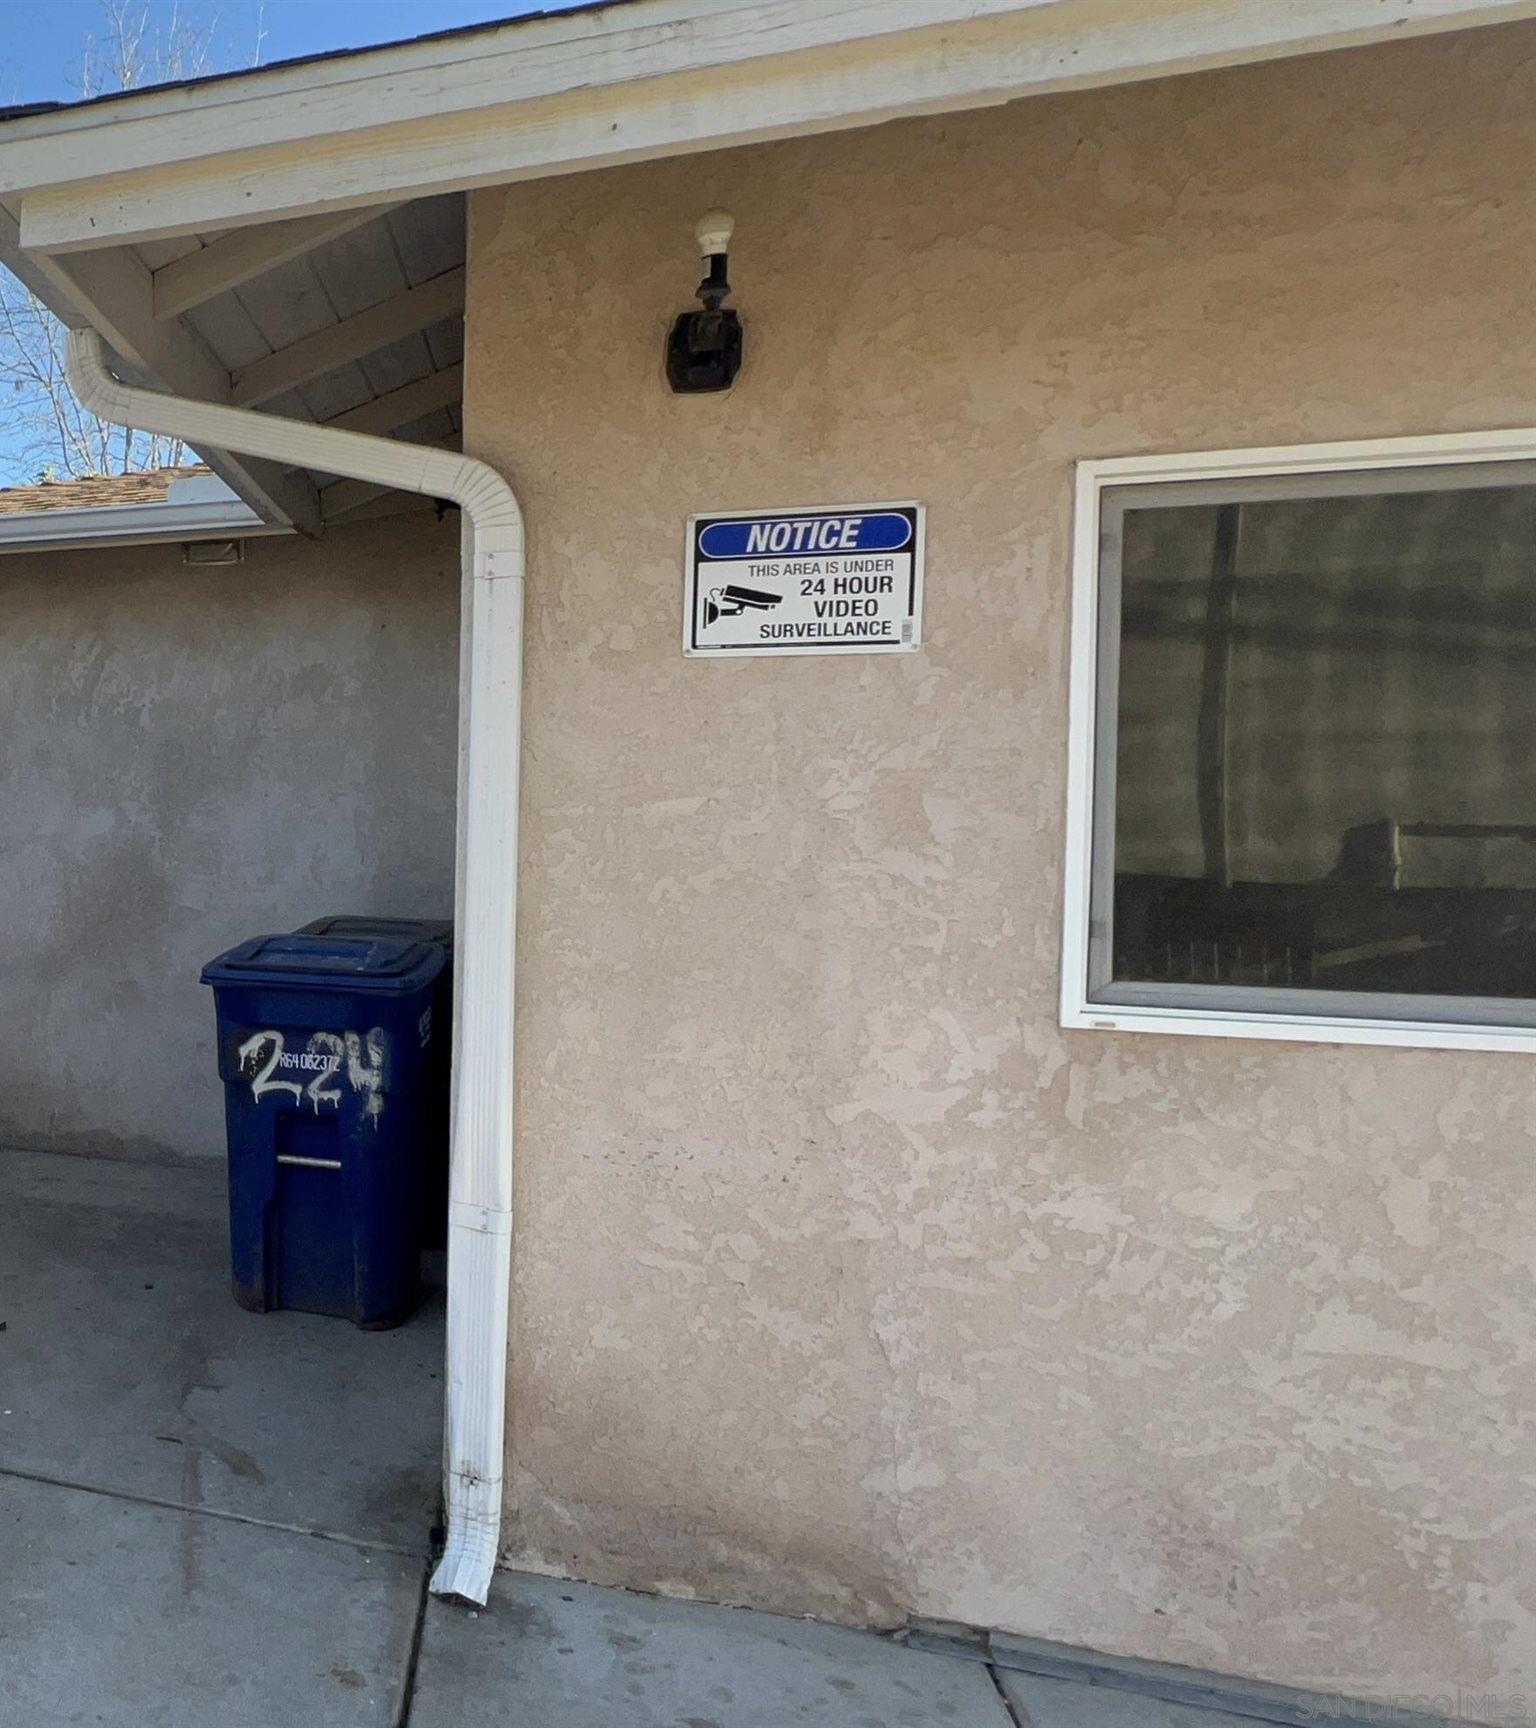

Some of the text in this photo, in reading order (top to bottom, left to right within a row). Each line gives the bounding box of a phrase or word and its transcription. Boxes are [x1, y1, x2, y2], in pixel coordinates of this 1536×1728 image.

[746, 519, 862, 553] NOTICE
[748, 559, 894, 577] THIS AREA IS UNDER
[800, 576, 893, 596] 24 HOUR
[814, 599, 879, 618] VIDEO
[760, 620, 892, 639] SURVEILLANCE
[238, 1026, 385, 1122] 224
